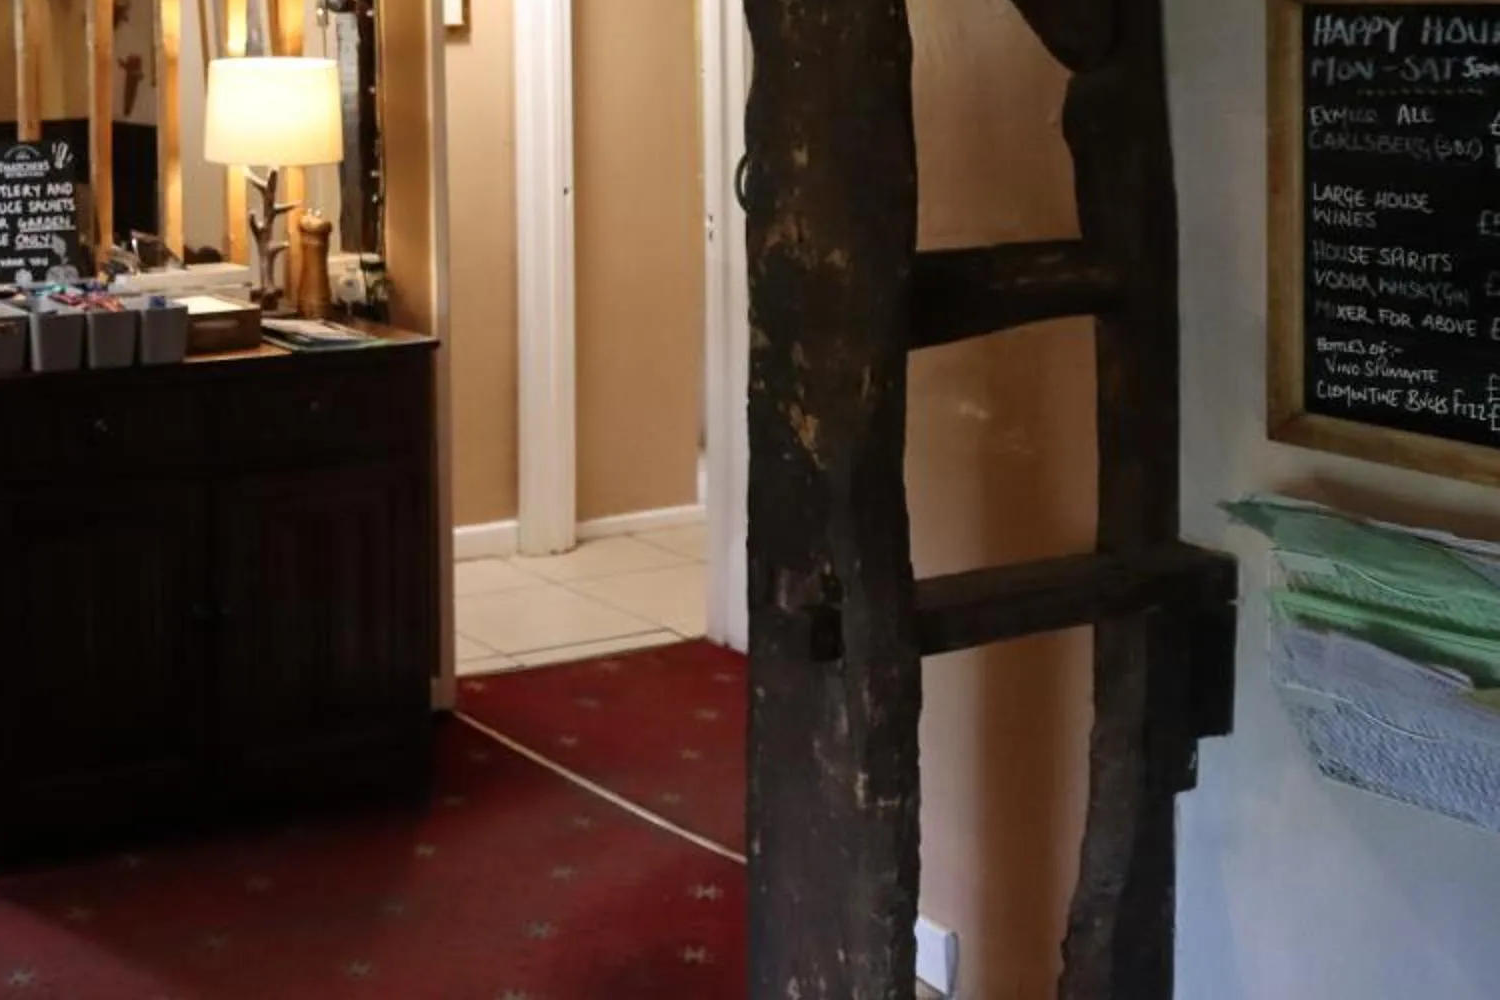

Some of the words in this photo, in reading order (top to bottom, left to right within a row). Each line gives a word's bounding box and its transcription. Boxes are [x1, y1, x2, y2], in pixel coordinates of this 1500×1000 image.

[1312, 13, 1403, 53] HAPPY
[47, 182, 73, 197] AND
[1313, 182, 1366, 208] LARGE
[1374, 190, 1435, 214] HOUSE
[29, 198, 76, 214] SACHETS
[1313, 207, 1377, 229] WINES
[29, 256, 49, 268] YOU
[1313, 240, 1373, 266] HOUSE
[1378, 247, 1453, 272] SPIRITS
[1314, 299, 1375, 325] MIXER
[1378, 308, 1414, 329] FOR
[1421, 314, 1477, 338] ABOVE
[1324, 356, 1360, 376] VINO
